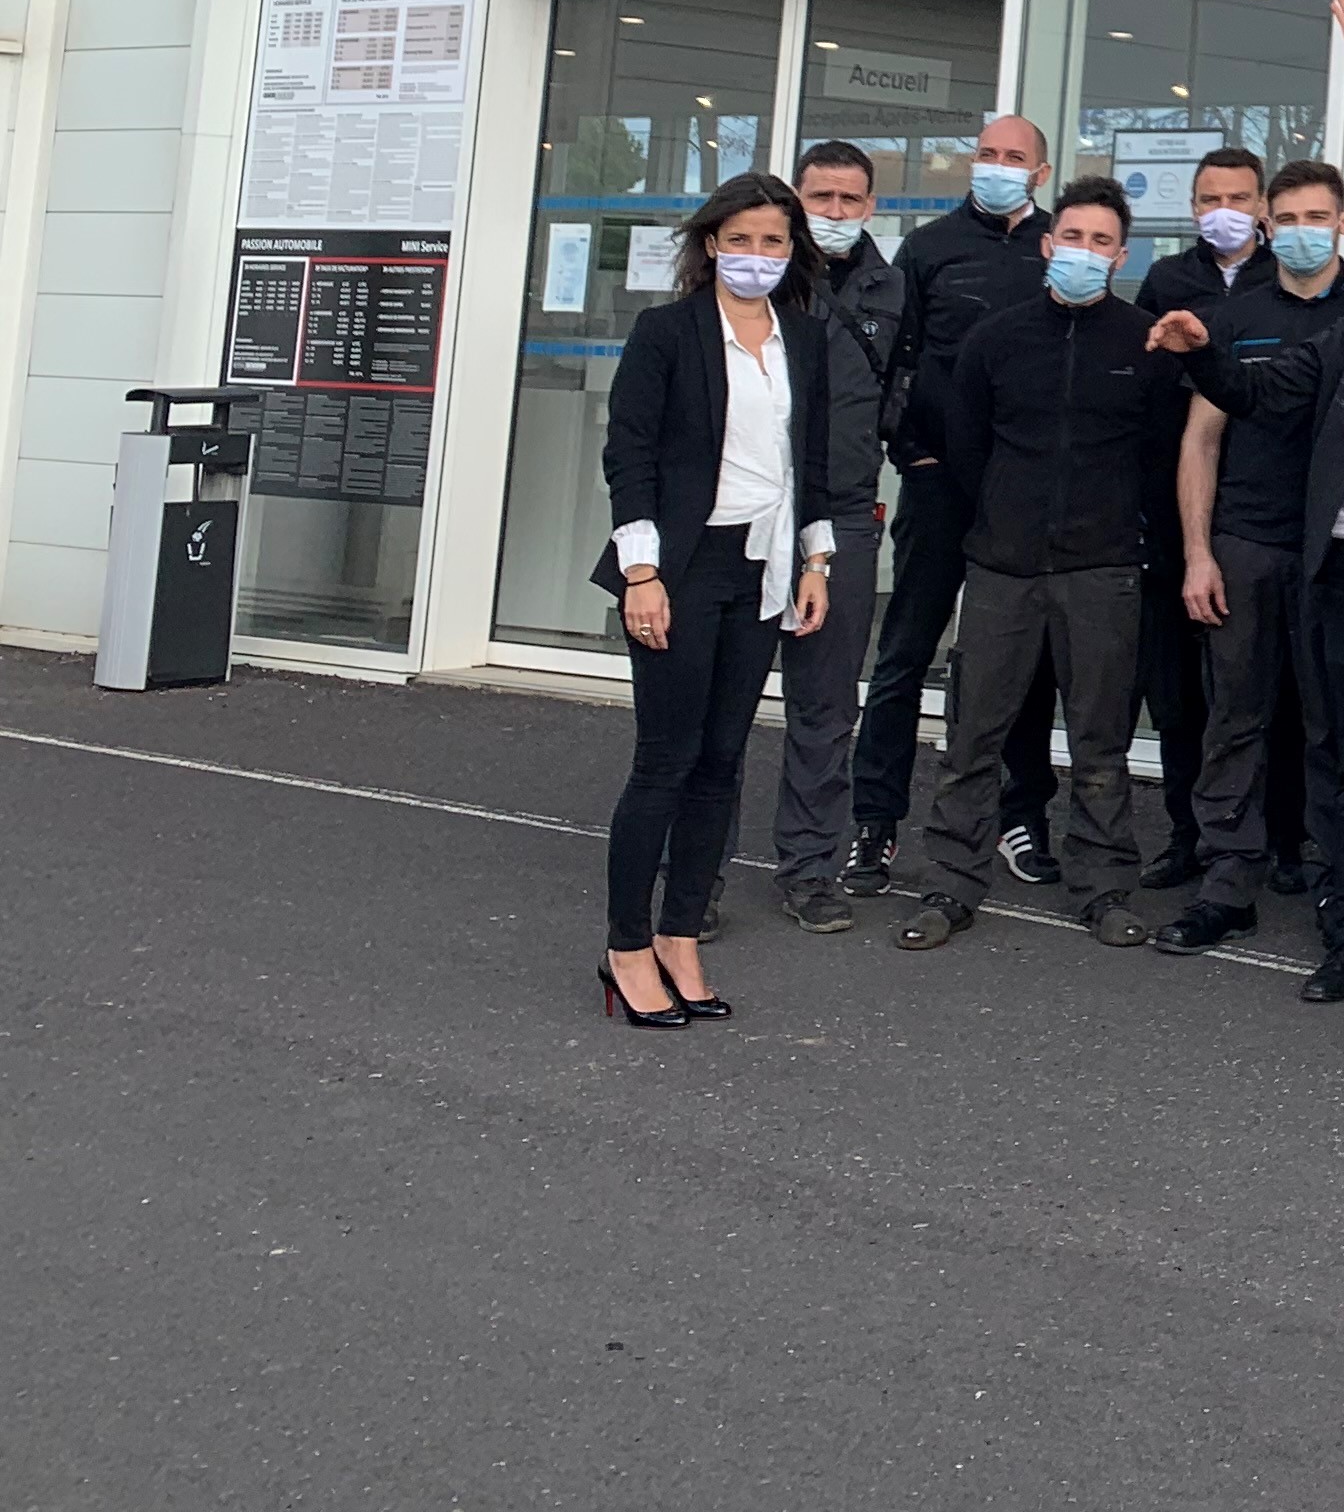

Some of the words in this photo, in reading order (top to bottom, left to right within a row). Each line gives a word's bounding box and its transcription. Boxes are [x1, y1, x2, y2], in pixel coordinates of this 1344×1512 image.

[848, 63, 930, 94] Accueil
[241, 238, 273, 251] PASSION
[273, 239, 323, 252] AUTOMOBILE
[401, 240, 420, 253] MINI
[420, 241, 449, 254] Service
